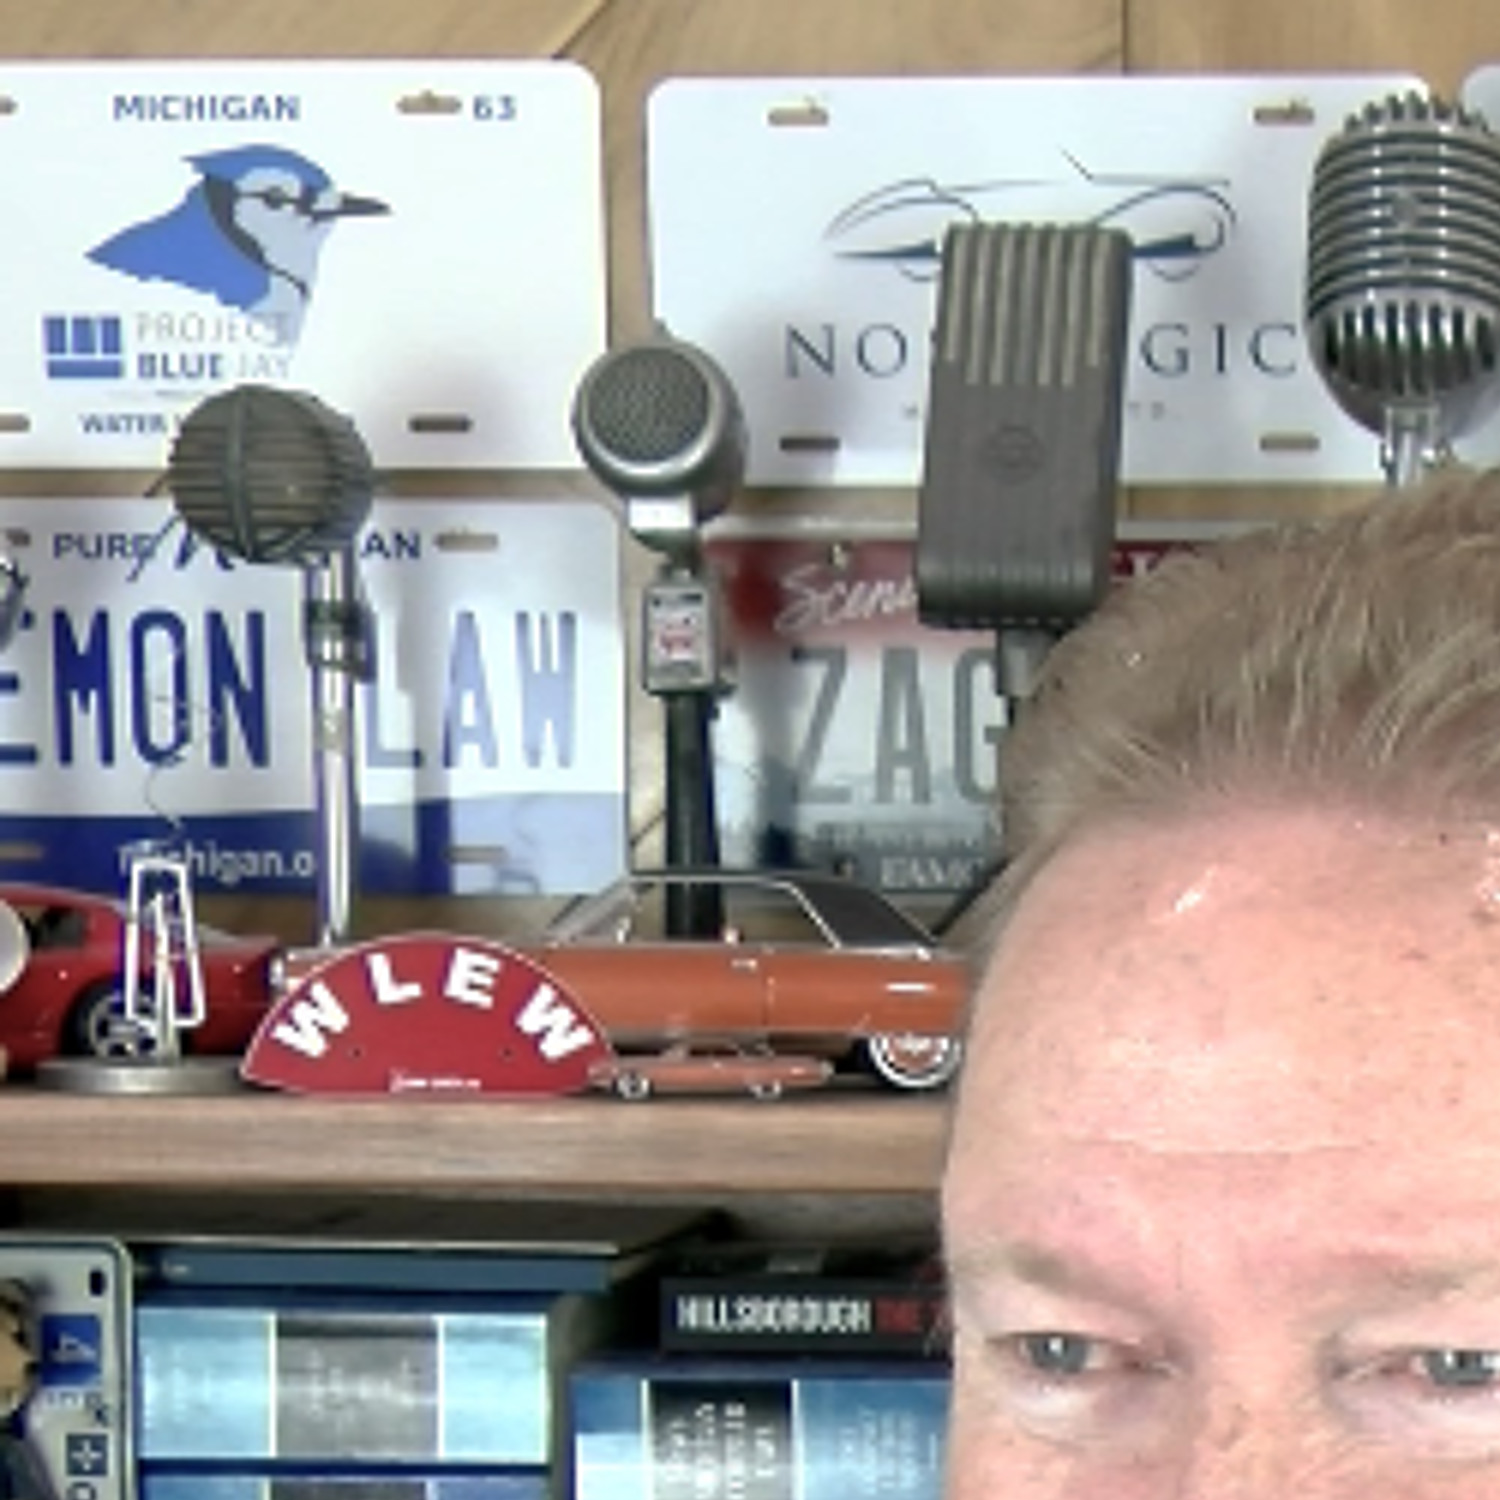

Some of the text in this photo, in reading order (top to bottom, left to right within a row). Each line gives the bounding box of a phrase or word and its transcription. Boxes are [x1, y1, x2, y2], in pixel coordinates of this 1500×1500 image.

[113, 94, 300, 122] MICHIGAN
[472, 95, 517, 121] 63
[138, 352, 222, 379] BLUE
[784, 322, 1299, 379] NOGIC
[79, 413, 168, 434] WATER
[364, 611, 578, 769] LAW
[270, 945, 594, 1061] WLEW
[677, 1296, 873, 1334] HILLSBOROUGH
